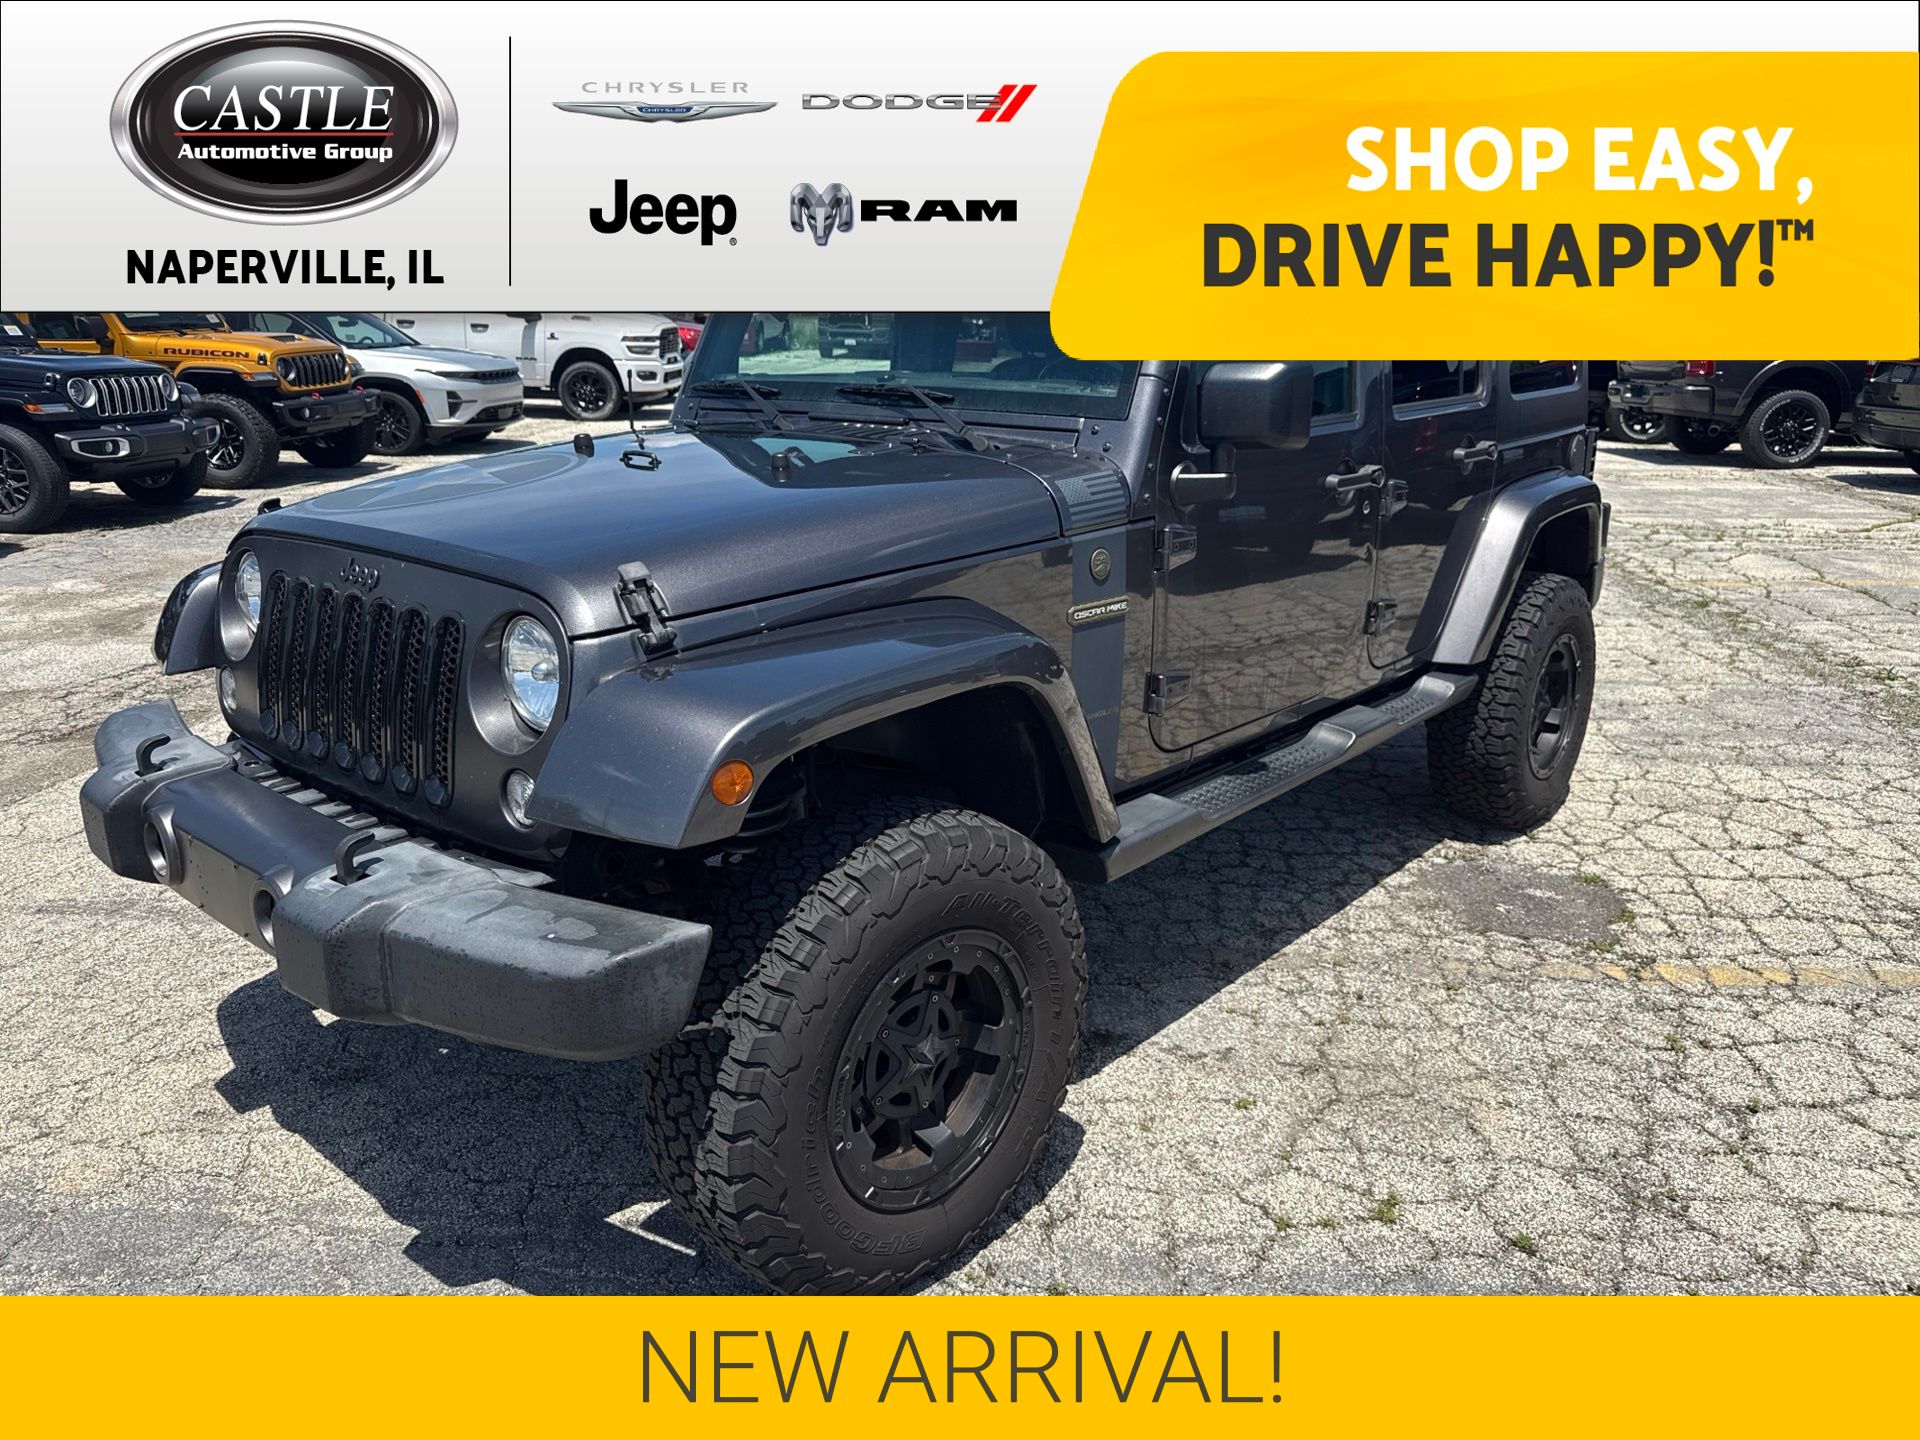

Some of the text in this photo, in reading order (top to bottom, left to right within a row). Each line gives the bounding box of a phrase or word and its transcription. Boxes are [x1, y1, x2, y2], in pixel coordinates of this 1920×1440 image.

[163, 346, 250, 359] RUBICON
[340, 556, 380, 592] Jeep
[1074, 601, 1128, 620] OSCAR MIKE
